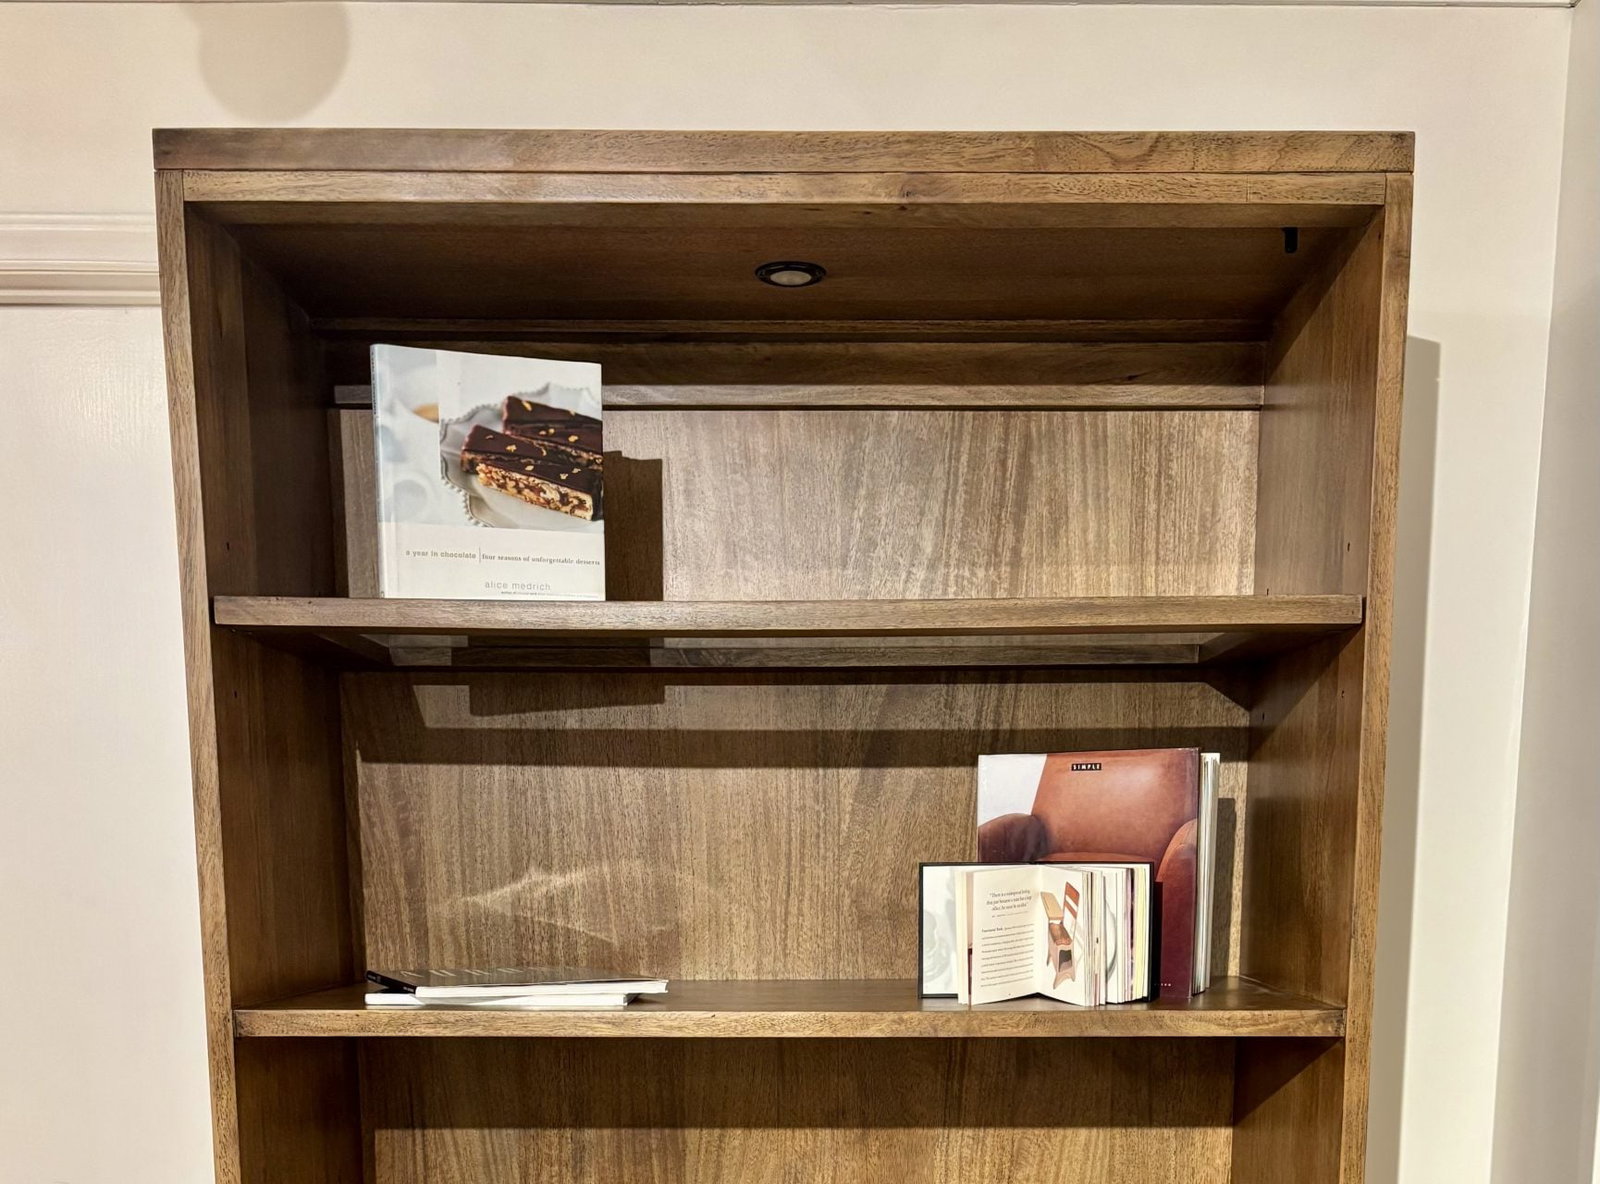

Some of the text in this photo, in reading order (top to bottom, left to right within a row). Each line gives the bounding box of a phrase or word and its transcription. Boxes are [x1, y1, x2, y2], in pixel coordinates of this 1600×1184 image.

[412, 550, 429, 559] year
[440, 551, 476, 559] chocolate
[482, 553, 496, 561] four
[531, 556, 574, 565] unforgettable
[575, 558, 601, 566] desserts
[484, 580, 551, 591] alice medrich
